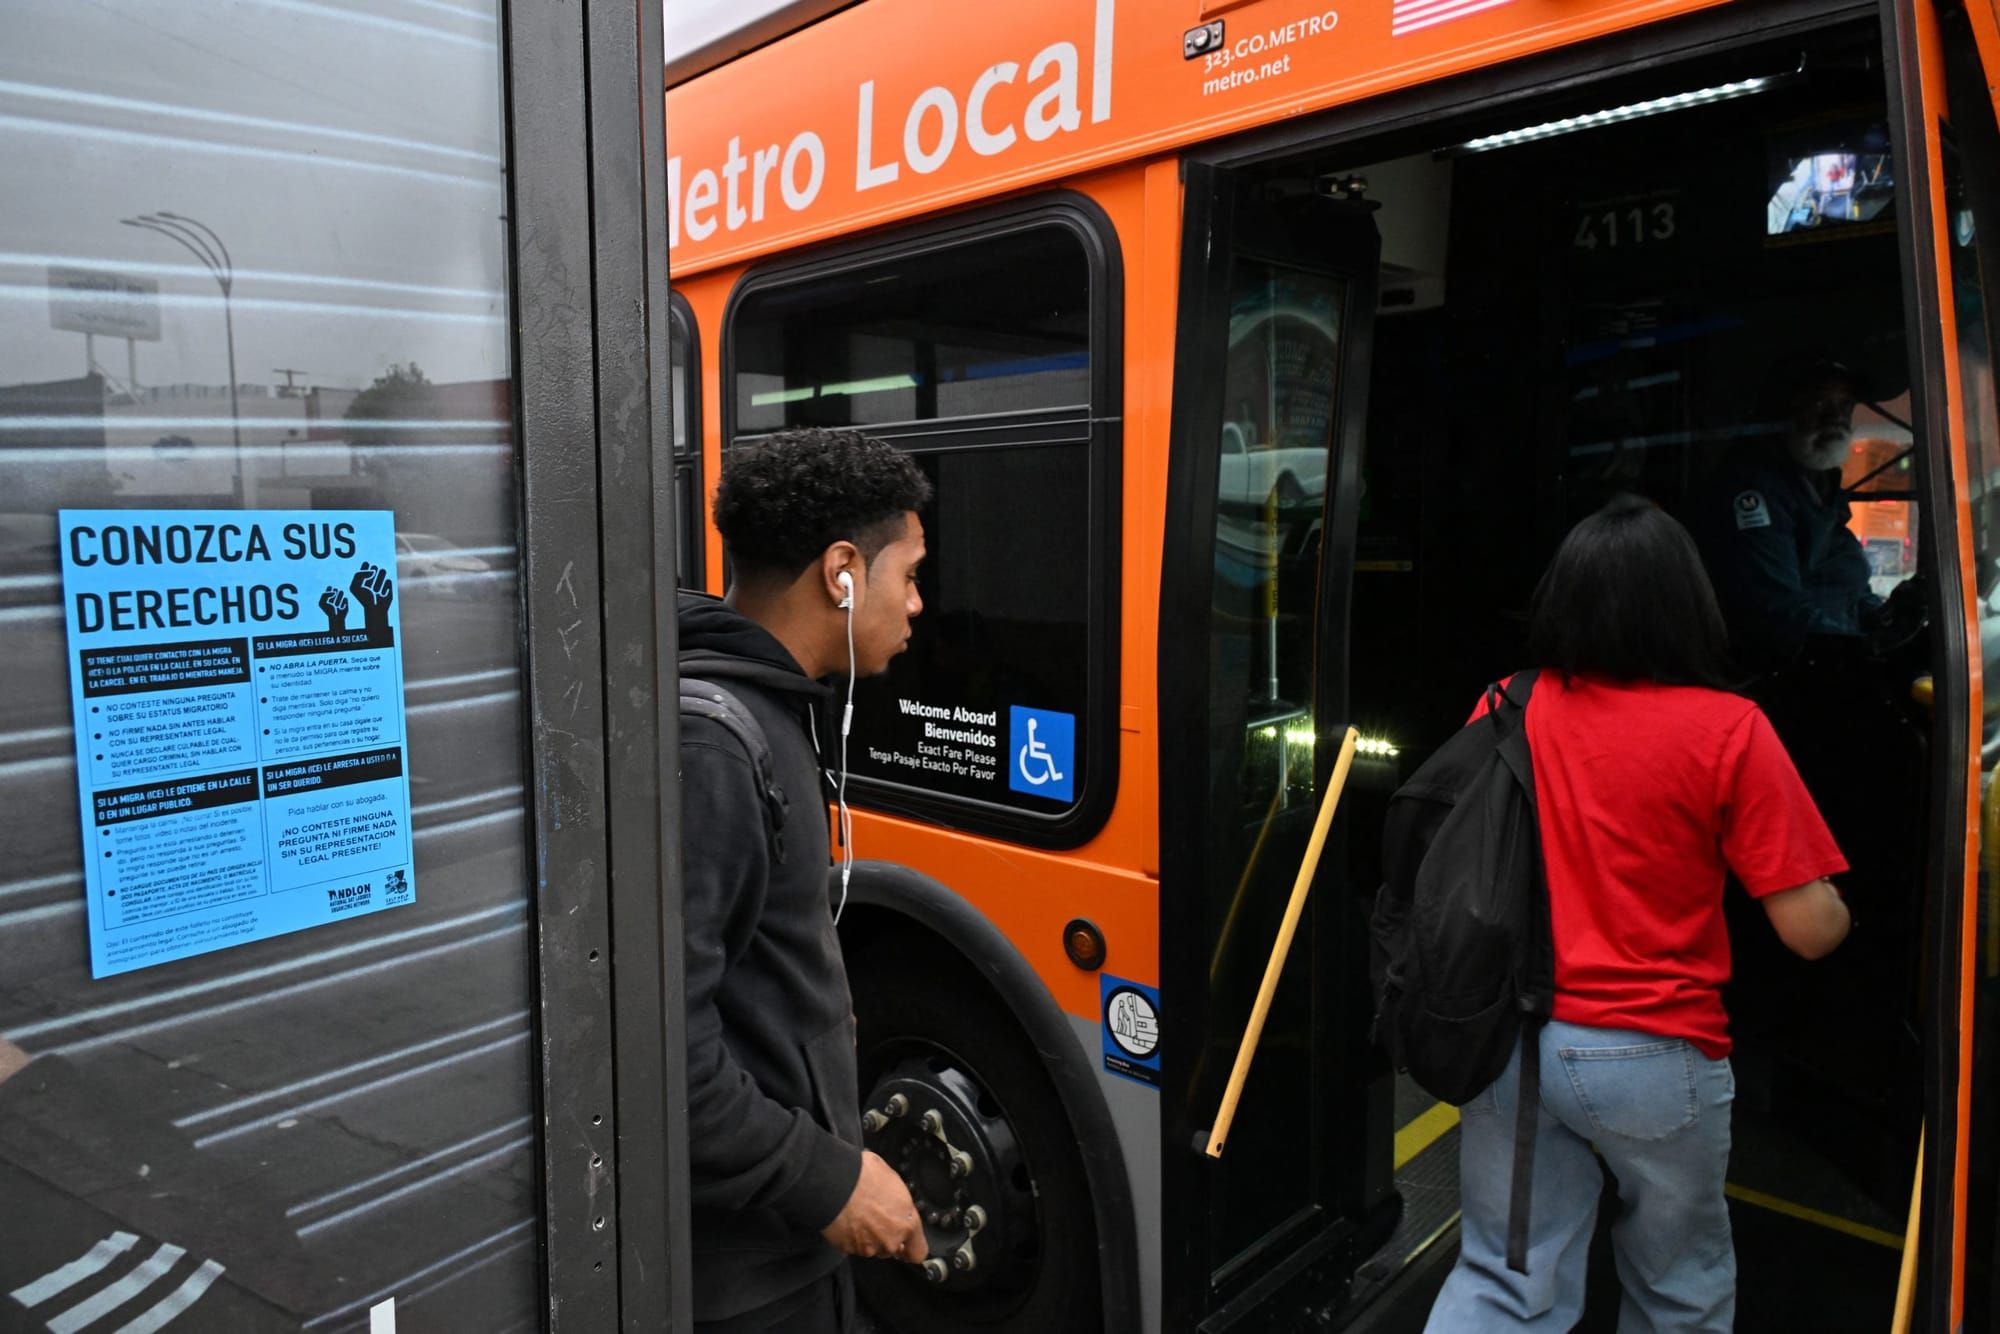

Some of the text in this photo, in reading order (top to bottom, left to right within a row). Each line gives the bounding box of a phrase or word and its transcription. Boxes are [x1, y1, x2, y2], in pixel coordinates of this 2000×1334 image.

[1204, 11, 1339, 73] 323.GO.METRO
[1203, 55, 1291, 95] metro.net
[856, 0, 1115, 192] Local
[1573, 202, 1676, 249] 4113
[69, 523, 356, 566] CONOZCA SUS
[77, 582, 300, 633] DERECHOS
[256, 641, 264, 650] SI
[265, 640, 274, 649] LA
[275, 639, 297, 648] MIGRA
[298, 638, 313, 647] (ICE)
[314, 636, 334, 646] LLEGA
[335, 636, 340, 644] A
[341, 635, 350, 643] SU
[269, 663, 281, 671] NO
[282, 661, 304, 670] ABRA
[306, 660, 316, 668] LA
[350, 656, 367, 664] Sepa
[106, 691, 235, 711] NO CONTESTE NINGUNA PREGUNTA
[107, 702, 228, 722] SOBRE SU ESTATUS MIGRATORIO
[899, 699, 997, 726] Welcome Aboard
[108, 715, 236, 737] NO FIRME NADA SIN ANTES HABLAR
[109, 726, 226, 747] CON SU REPRESENTANTE LEGAL
[924, 722, 996, 747] Bienvenidos
[110, 749, 133, 759] NUNCA
[134, 748, 143, 756] SE
[144, 744, 175, 755] DECLARE
[176, 740, 209, 750] CULPABLE
[111, 745, 241, 768] QUIER CARGO CRIMINAL SIN HABLAR CON
[918, 741, 996, 766] Exact Fare Please
[112, 759, 200, 777] SU REPRESENTANTE LEGAL
[266, 770, 273, 780] SI
[274, 769, 283, 779] LA
[284, 766, 306, 777] MIGRA
[307, 763, 322, 774] (ICE)
[323, 762, 331, 771] LE
[332, 758, 359, 770] ARRESTA
[360, 757, 365, 766] A
[386, 753, 390, 762] O
[391, 753, 396, 761] A
[869, 747, 996, 780] Tenga Pasaje Exacto Por Favor
[97, 775, 251, 807] SI LA MIGRA (ICE) LE DETIENE EN LA CALLE
[266, 782, 277, 792] UN
[278, 780, 291, 790] SER
[98, 811, 104, 820] O
[106, 809, 117, 819] EN
[118, 807, 130, 817] UN
[131, 802, 157, 815] LUGAR
[288, 806, 304, 816] Pida
[306, 802, 329, 813] hablar
[330, 801, 343, 809] con
[301, 817, 350, 833] CONTESTE
[352, 809, 393, 824] NINGUNA
[278, 819, 397, 848] PREGUNTA NI FIRME NADA
[281, 848, 296, 858] SIN
[299, 845, 312, 855] SU
[298, 842, 381, 866] LEGAL PRESENTE!
[337, 883, 370, 899] NDLON
